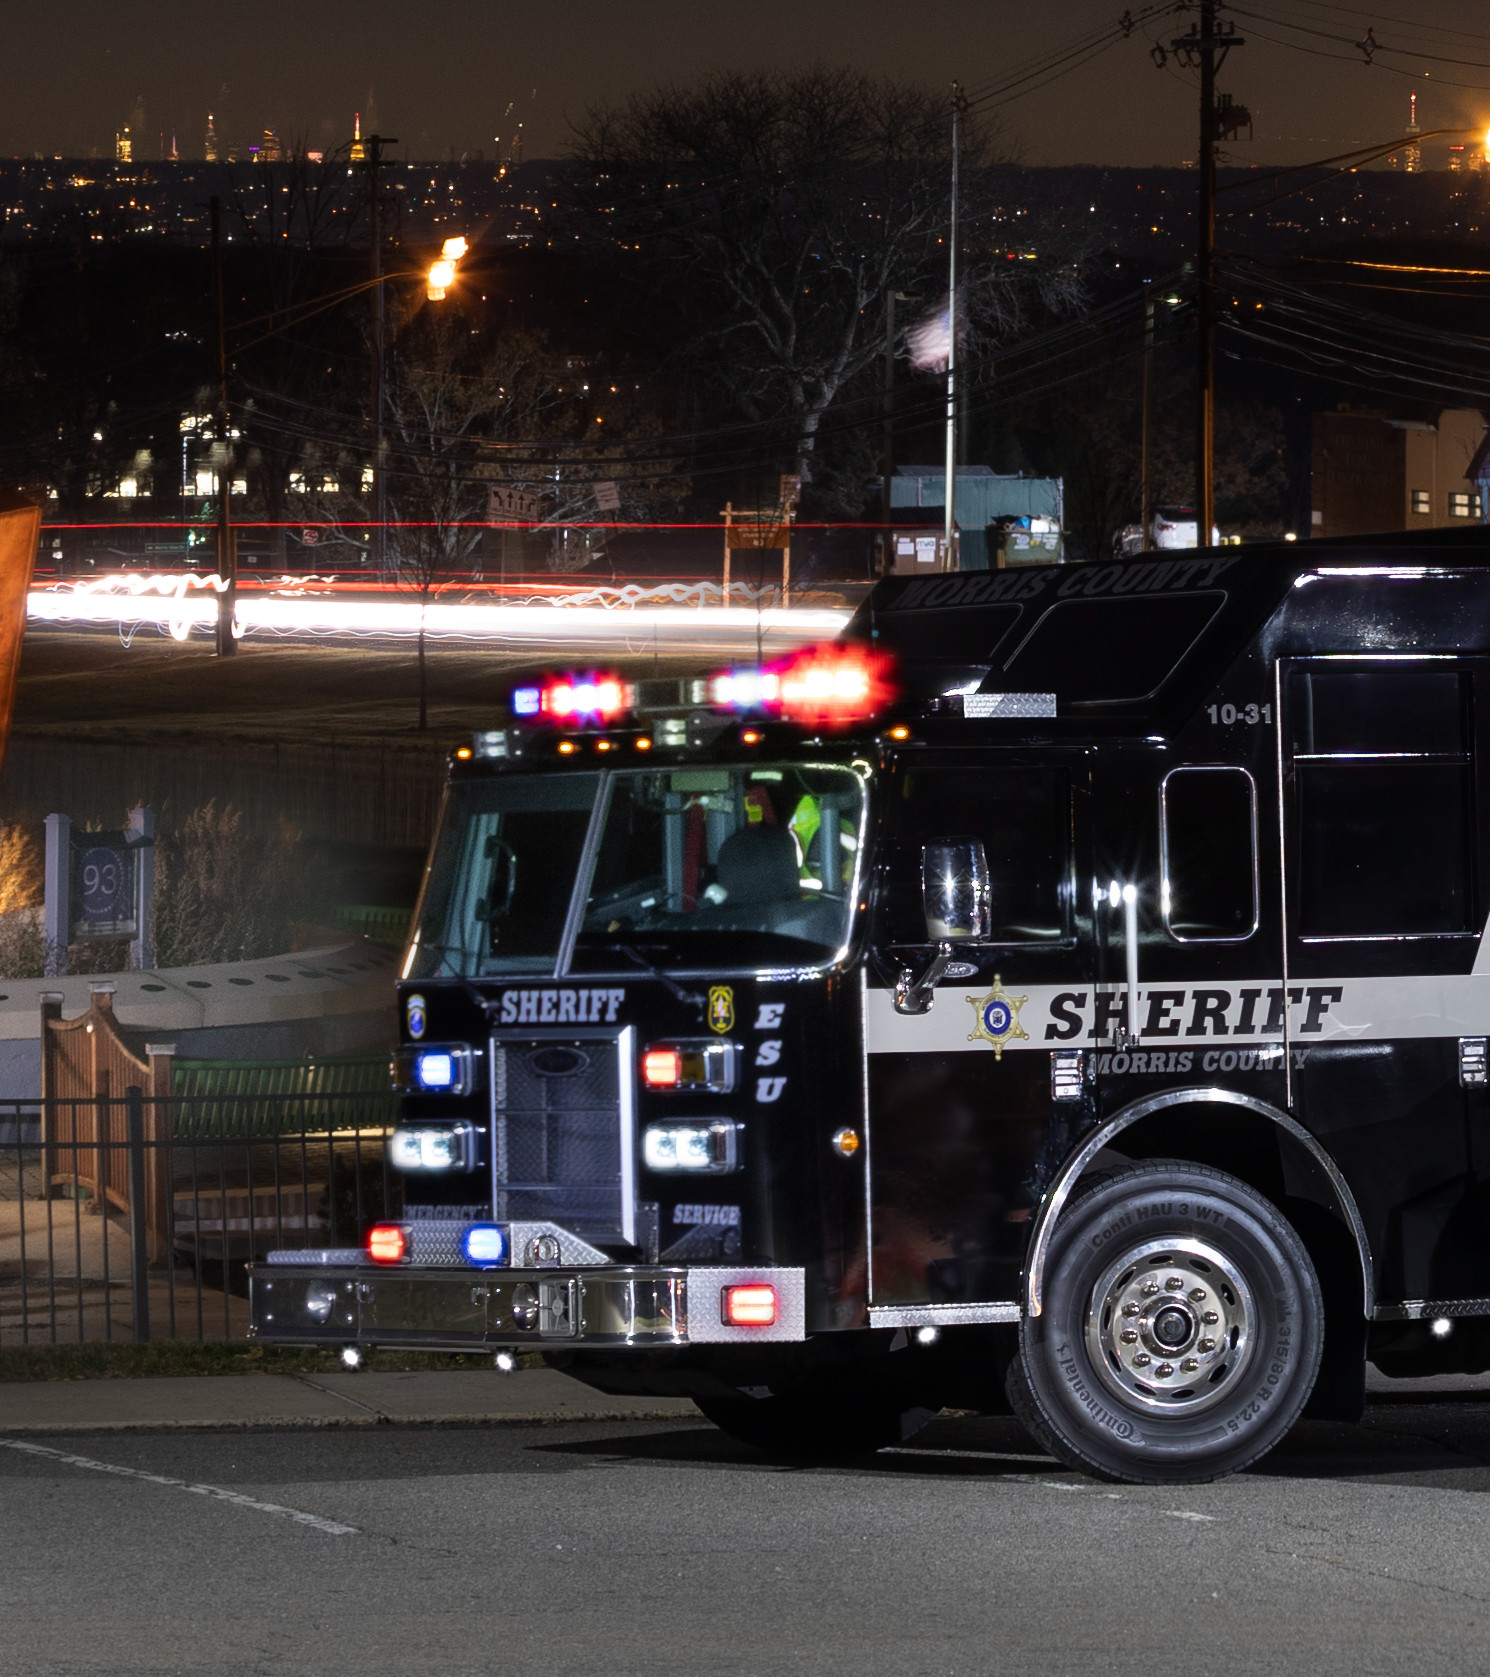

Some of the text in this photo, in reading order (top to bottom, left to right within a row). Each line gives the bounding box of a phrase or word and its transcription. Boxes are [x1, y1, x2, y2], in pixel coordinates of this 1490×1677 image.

[887, 556, 1242, 610] MORRIS COUNTY
[1207, 704, 1272, 725] 10-31
[83, 865, 117, 895] 93
[501, 988, 625, 1024] SHERIFF
[1044, 986, 1343, 1042] SHERIFF
[1089, 1049, 1310, 1076] MORRIS COUNTY
[673, 1203, 741, 1226] SERVICE
[1091, 1202, 1225, 1248] Conti HAU 3 WT
[1060, 1354, 1136, 1440] Continental
[1228, 1327, 1291, 1433] 315/80 R 22.5
